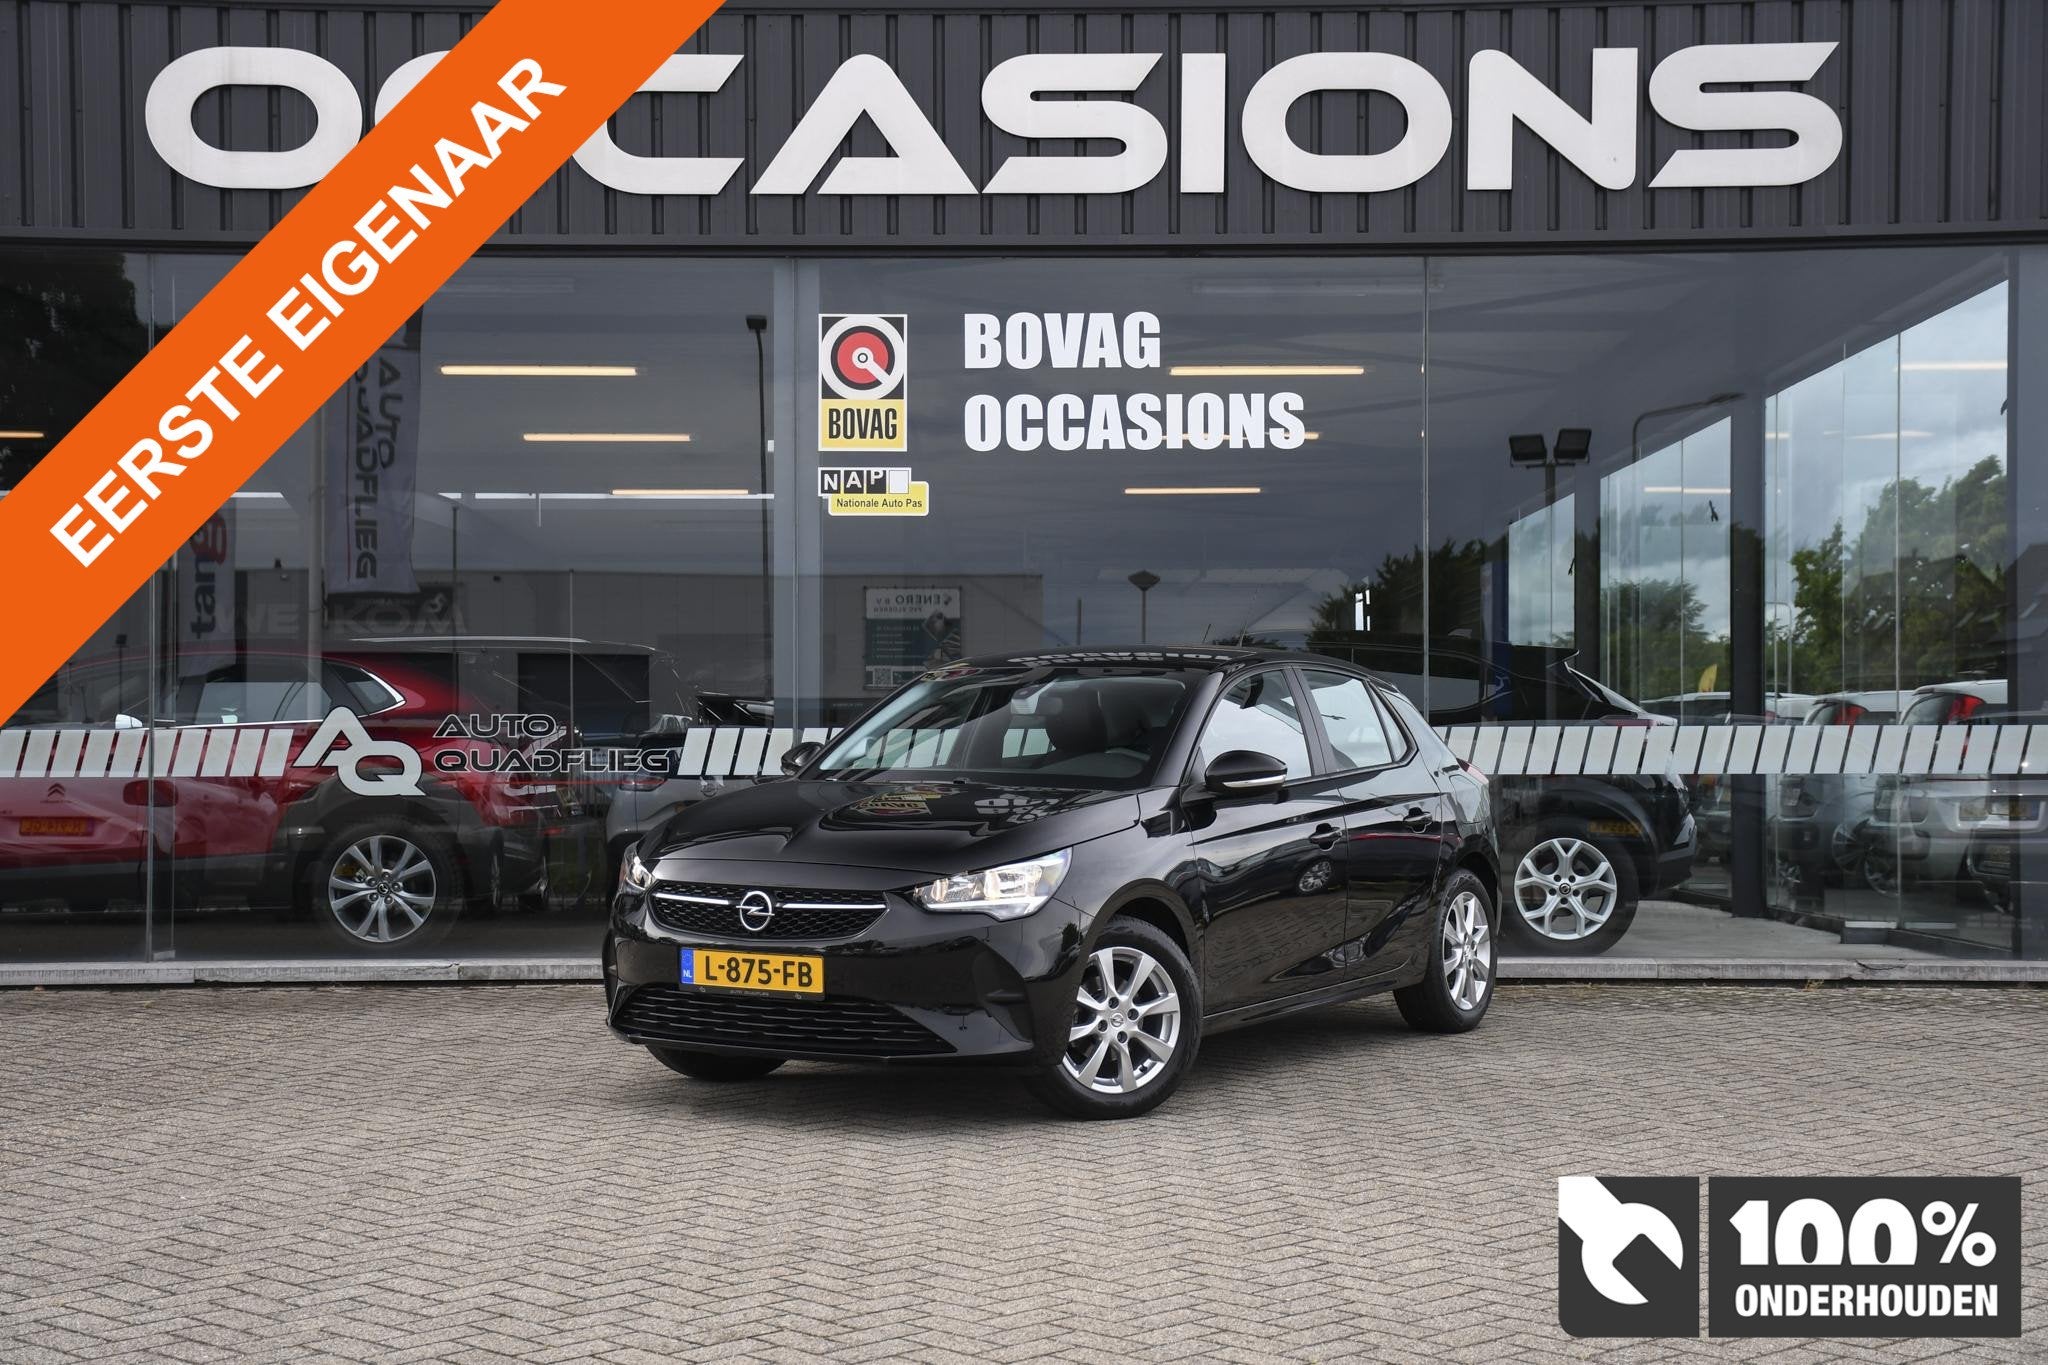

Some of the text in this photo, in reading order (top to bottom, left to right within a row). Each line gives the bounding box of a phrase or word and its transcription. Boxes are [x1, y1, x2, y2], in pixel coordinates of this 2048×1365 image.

[145, 41, 1843, 196] OCASIONS
[964, 311, 1161, 370] BOVAG
[828, 407, 898, 440] BOVAG
[964, 391, 1306, 452] OCCASIONS
[823, 469, 884, 491] NAP
[836, 497, 923, 508] Nationale Auto Pas
[433, 713, 557, 738] AUTO
[293, 704, 426, 797] AQ
[433, 748, 671, 773] QUADFLIEG
[682, 955, 813, 988] NL L-875-FB
